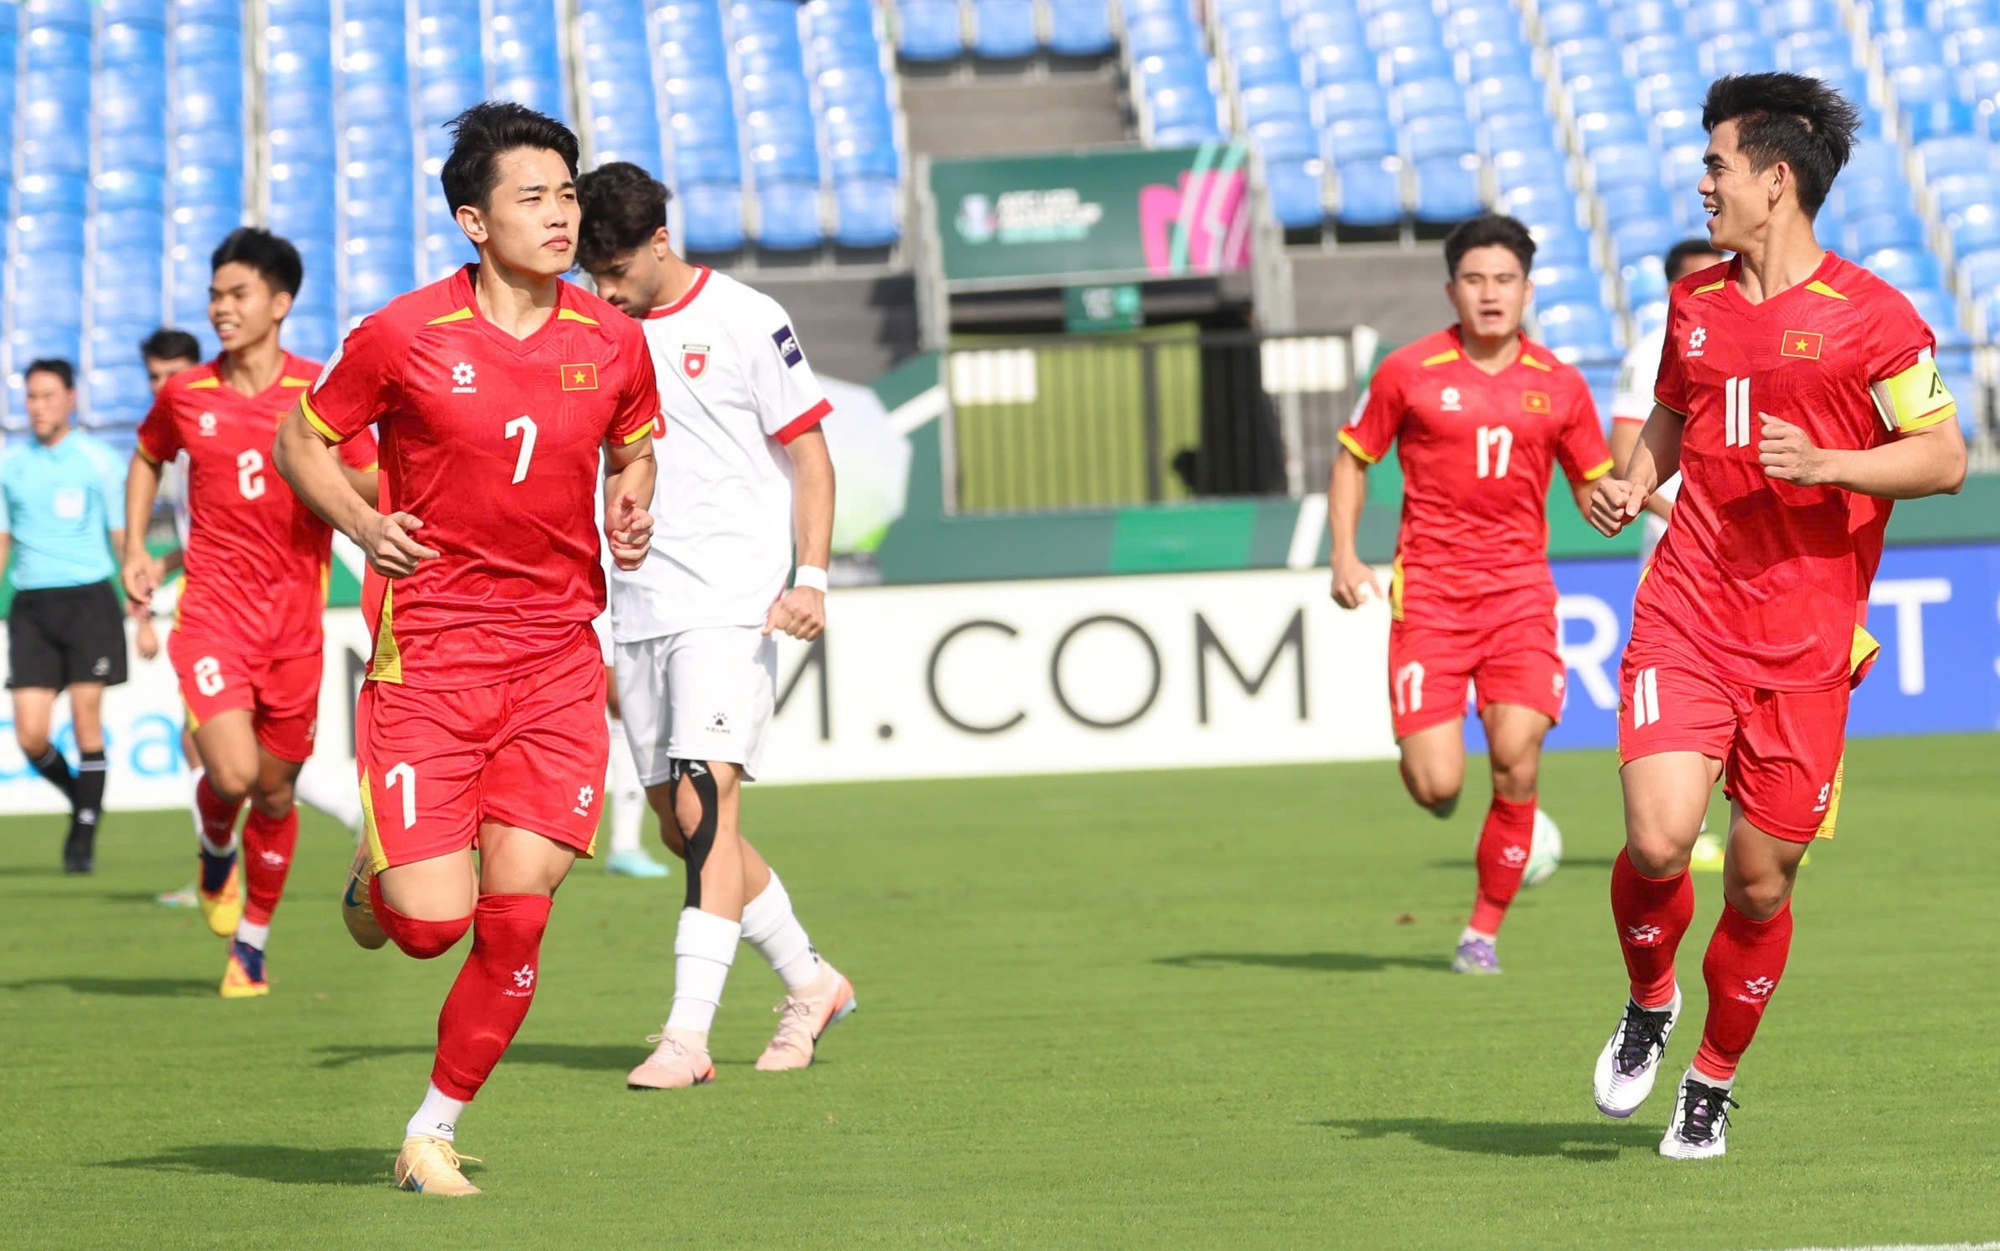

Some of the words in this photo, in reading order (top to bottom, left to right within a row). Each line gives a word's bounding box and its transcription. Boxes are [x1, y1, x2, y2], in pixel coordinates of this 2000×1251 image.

[1725, 376, 1750, 448] 11
[236, 448, 266, 500] 2
[505, 415, 538, 485] 7
[1476, 425, 1514, 479] 17
[193, 656, 226, 697] 2
[1394, 660, 1426, 716] 17
[1633, 667, 1661, 730] 11
[385, 761, 418, 830] 7
